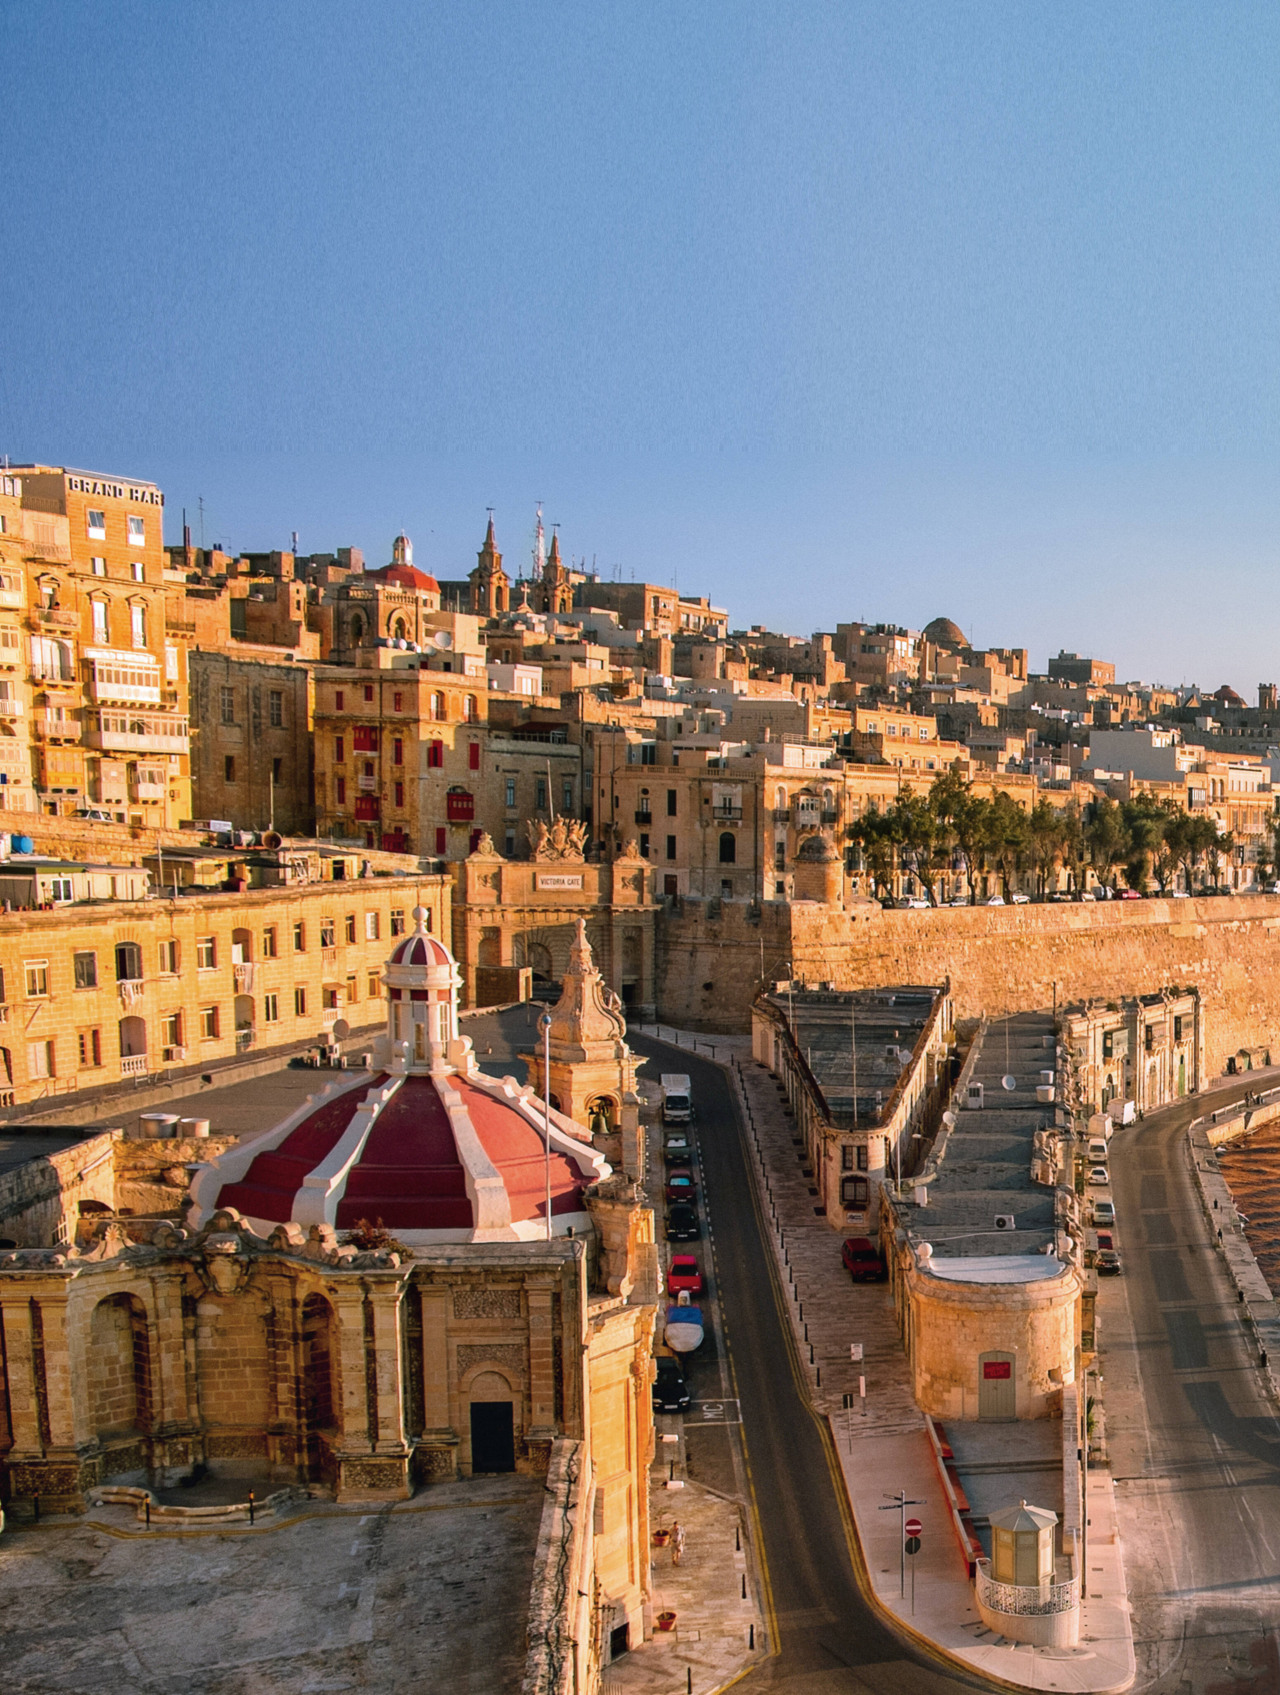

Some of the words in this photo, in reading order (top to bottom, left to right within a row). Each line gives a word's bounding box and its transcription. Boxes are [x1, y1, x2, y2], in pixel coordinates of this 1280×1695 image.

[68, 478, 123, 498] GRAND
[129, 488, 165, 506] HAR
[540, 878, 566, 886] VICTORIA
[567, 878, 580, 886] GATE
[702, 1404, 724, 1419] MC
